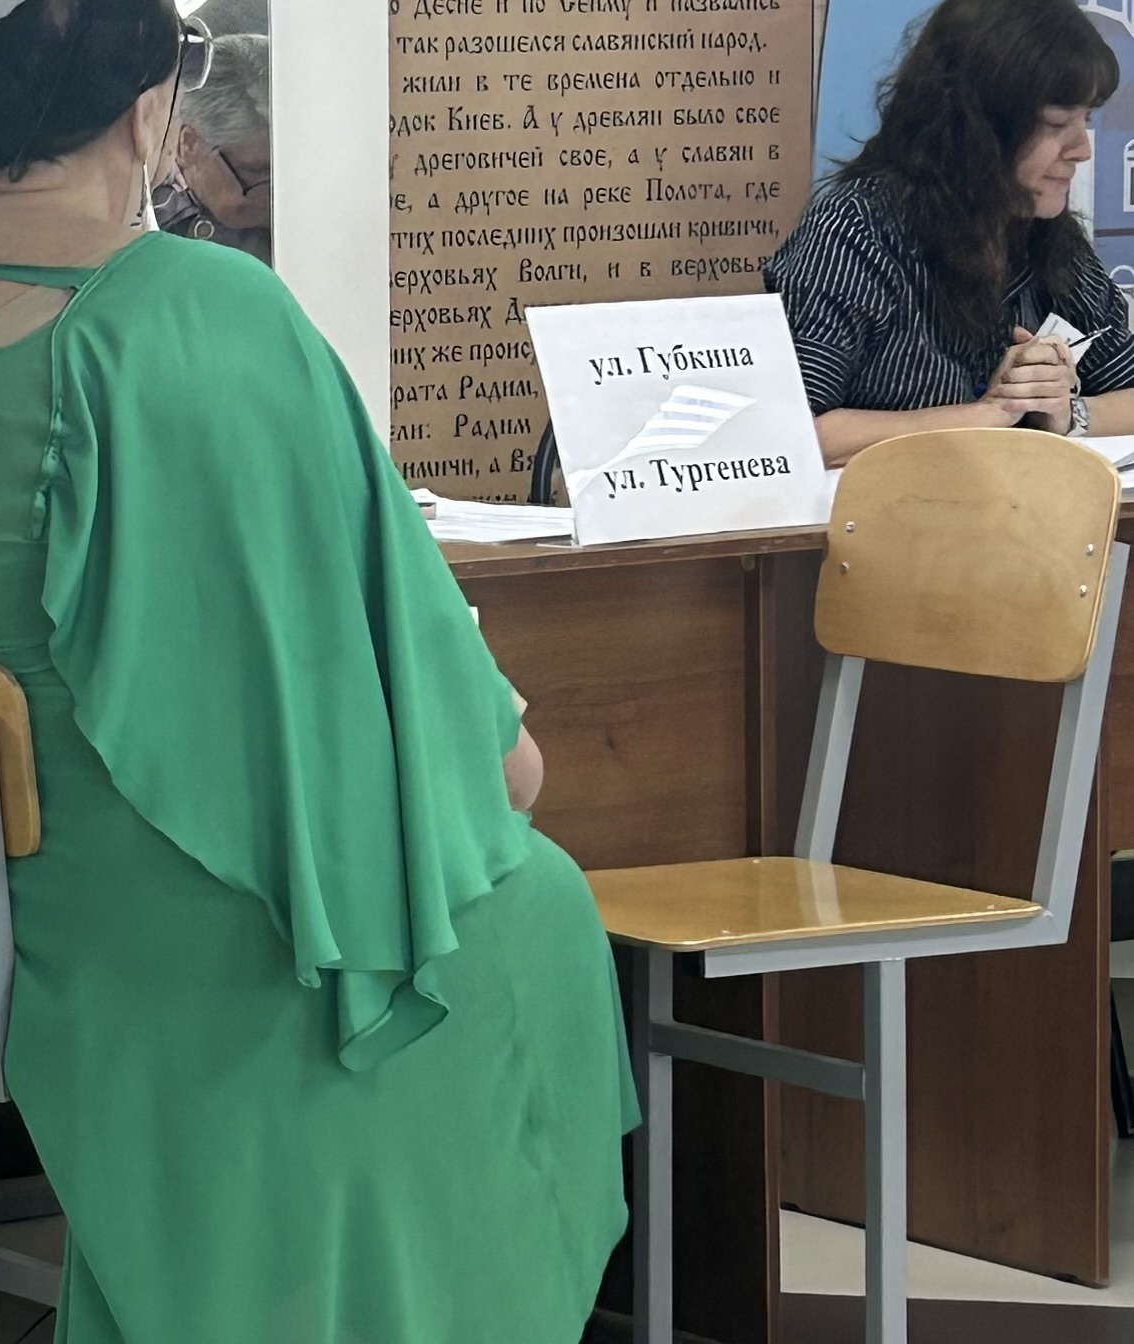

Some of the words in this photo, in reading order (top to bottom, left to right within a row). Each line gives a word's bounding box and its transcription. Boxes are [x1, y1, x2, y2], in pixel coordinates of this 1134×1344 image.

[395, 36, 439, 55] так
[444, 34, 566, 62] разошелся
[571, 28, 695, 52] славянский
[701, 31, 768, 57] народ.
[402, 75, 461, 94] жили
[476, 74, 489, 92] в
[502, 73, 533, 92] те
[547, 71, 641, 98] времена
[654, 69, 755, 93] отдельно
[768, 69, 781, 85] и
[522, 104, 540, 130] А
[550, 111, 564, 138] у
[572, 109, 662, 136] древлян
[673, 107, 725, 126] было
[735, 106, 781, 124] свое
[413, 145, 544, 178] дреговичей
[558, 148, 613, 169] свое,
[627, 148, 640, 165] а
[654, 147, 668, 172] у
[681, 144, 754, 164] славян
[768, 144, 780, 161] в
[427, 192, 441, 209] а
[453, 188, 530, 217] другое
[544, 187, 569, 206] на
[583, 186, 632, 212] реке
[645, 177, 732, 202] Полота,
[745, 181, 781, 203] где
[441, 226, 557, 251] последних
[563, 221, 681, 250] произошли
[688, 219, 780, 246] кривичи,
[517, 257, 588, 284] Волги,
[607, 261, 620, 280] и
[639, 261, 652, 278] в
[431, 344, 463, 364] же
[588, 356, 633, 385] ул.
[635, 344, 754, 380] Губкина
[458, 374, 539, 404] Радим,
[488, 456, 501, 474] а
[603, 469, 645, 499] ул.
[649, 455, 791, 493] Тургенева
